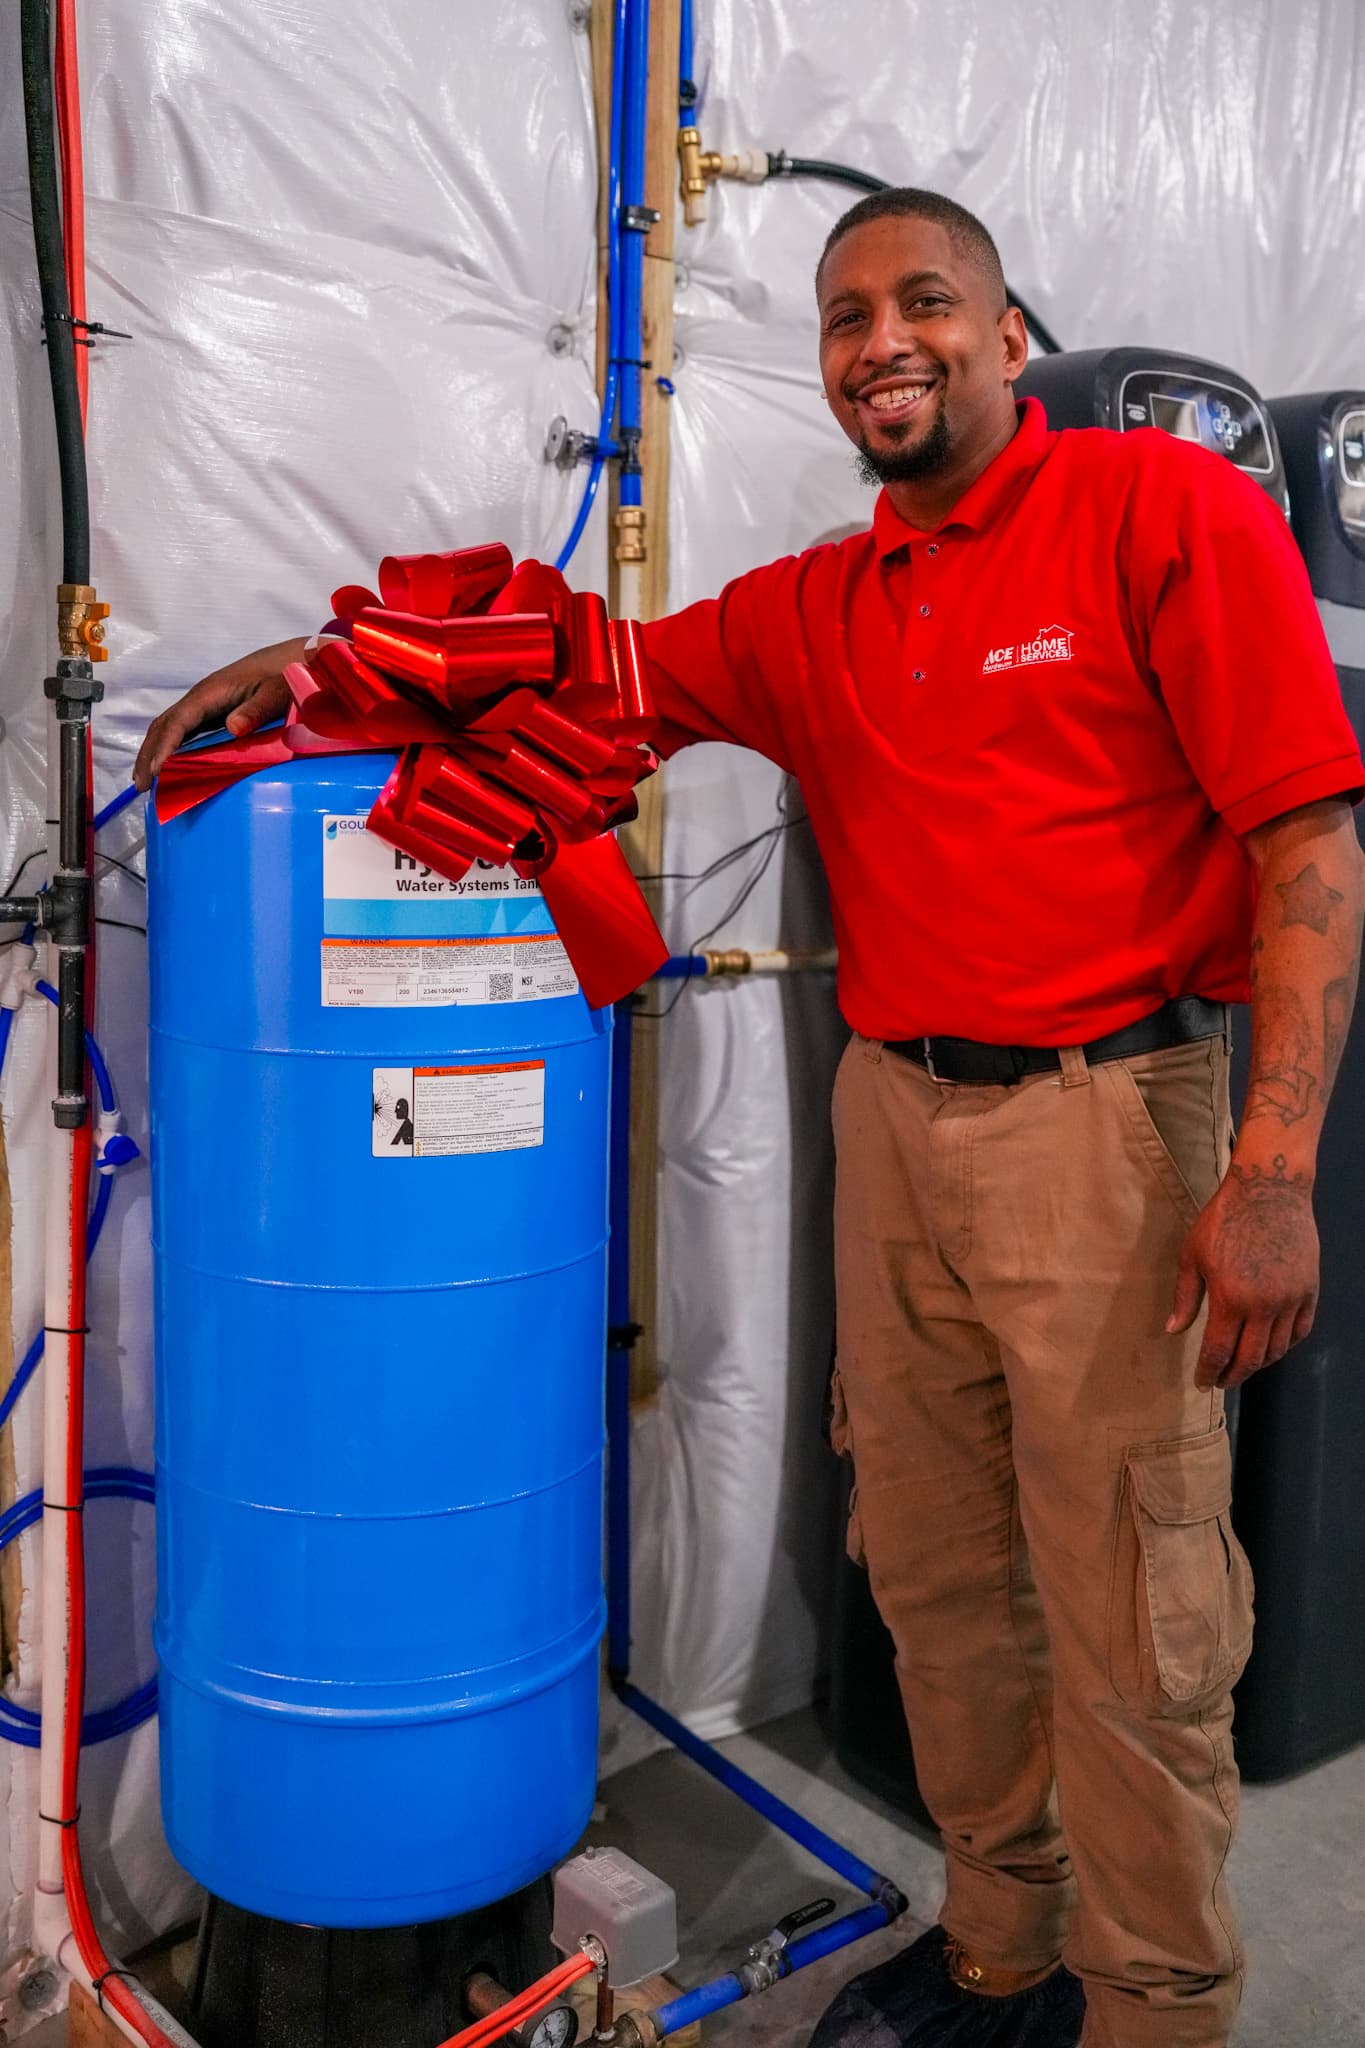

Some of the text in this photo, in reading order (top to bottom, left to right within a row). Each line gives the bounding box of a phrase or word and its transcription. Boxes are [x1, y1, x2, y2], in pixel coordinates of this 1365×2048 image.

[1021, 637, 1067, 654] HOME
[983, 647, 1014, 665] ACE
[1020, 648, 1068, 663] SERVICES
[339, 820, 365, 830] GOU
[396, 879, 444, 892] Water
[449, 879, 509, 894] Systems
[521, 976, 534, 986] NSF
